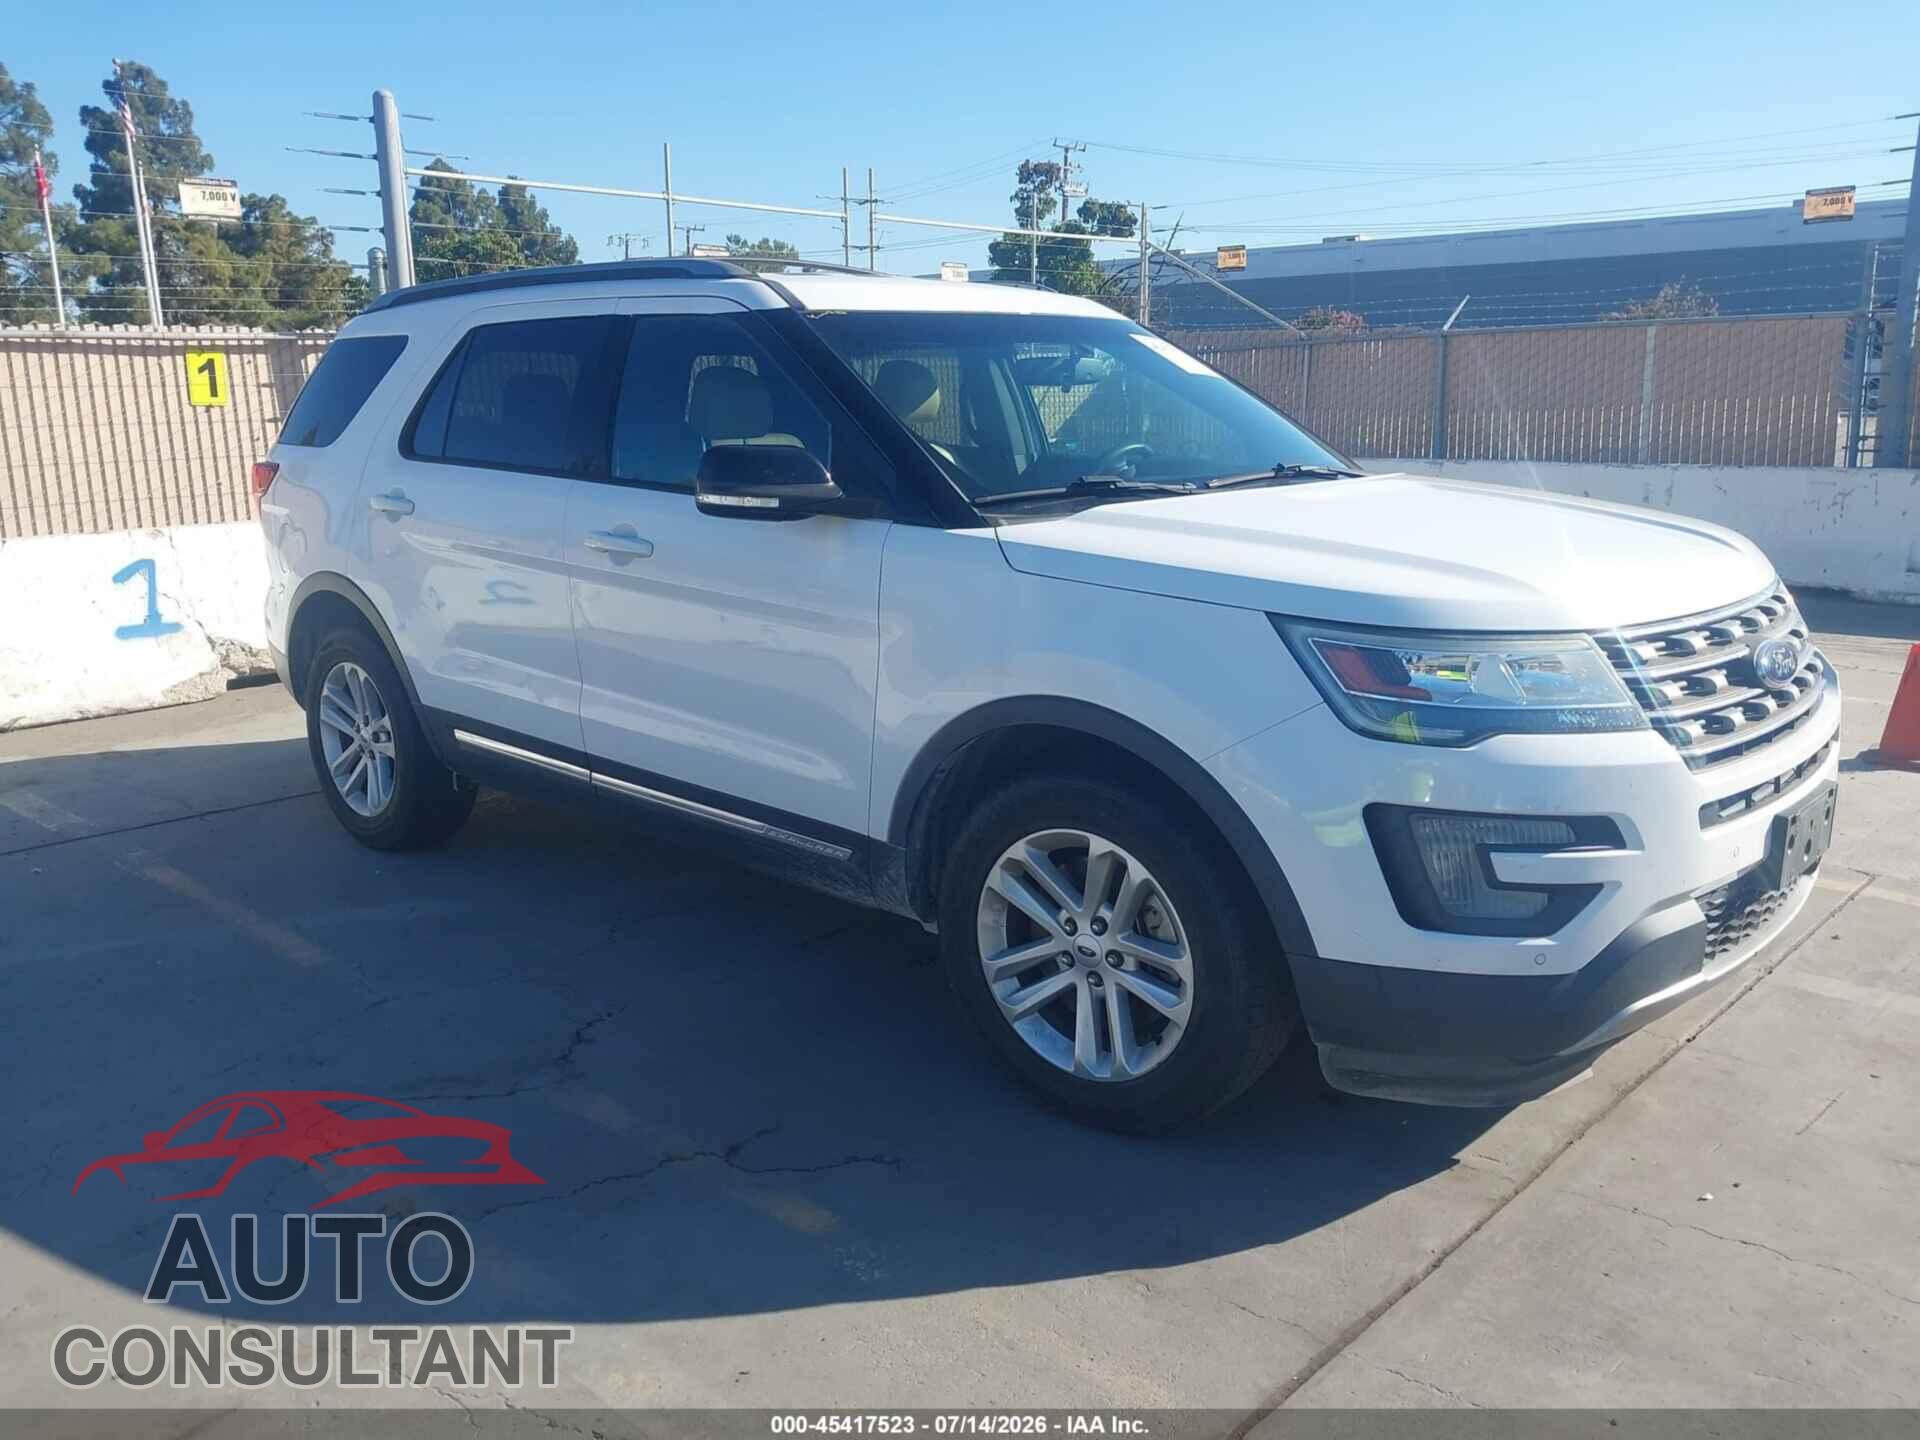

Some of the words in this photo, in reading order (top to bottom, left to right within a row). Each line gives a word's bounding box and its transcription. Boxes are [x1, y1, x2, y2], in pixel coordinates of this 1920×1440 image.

[200, 190, 228, 202] 7,000
[230, 192, 237, 203] V
[1823, 196, 1846, 206] 7,000
[1847, 195, 1854, 204] V
[197, 358, 218, 398] 1
[112, 558, 185, 640] 1
